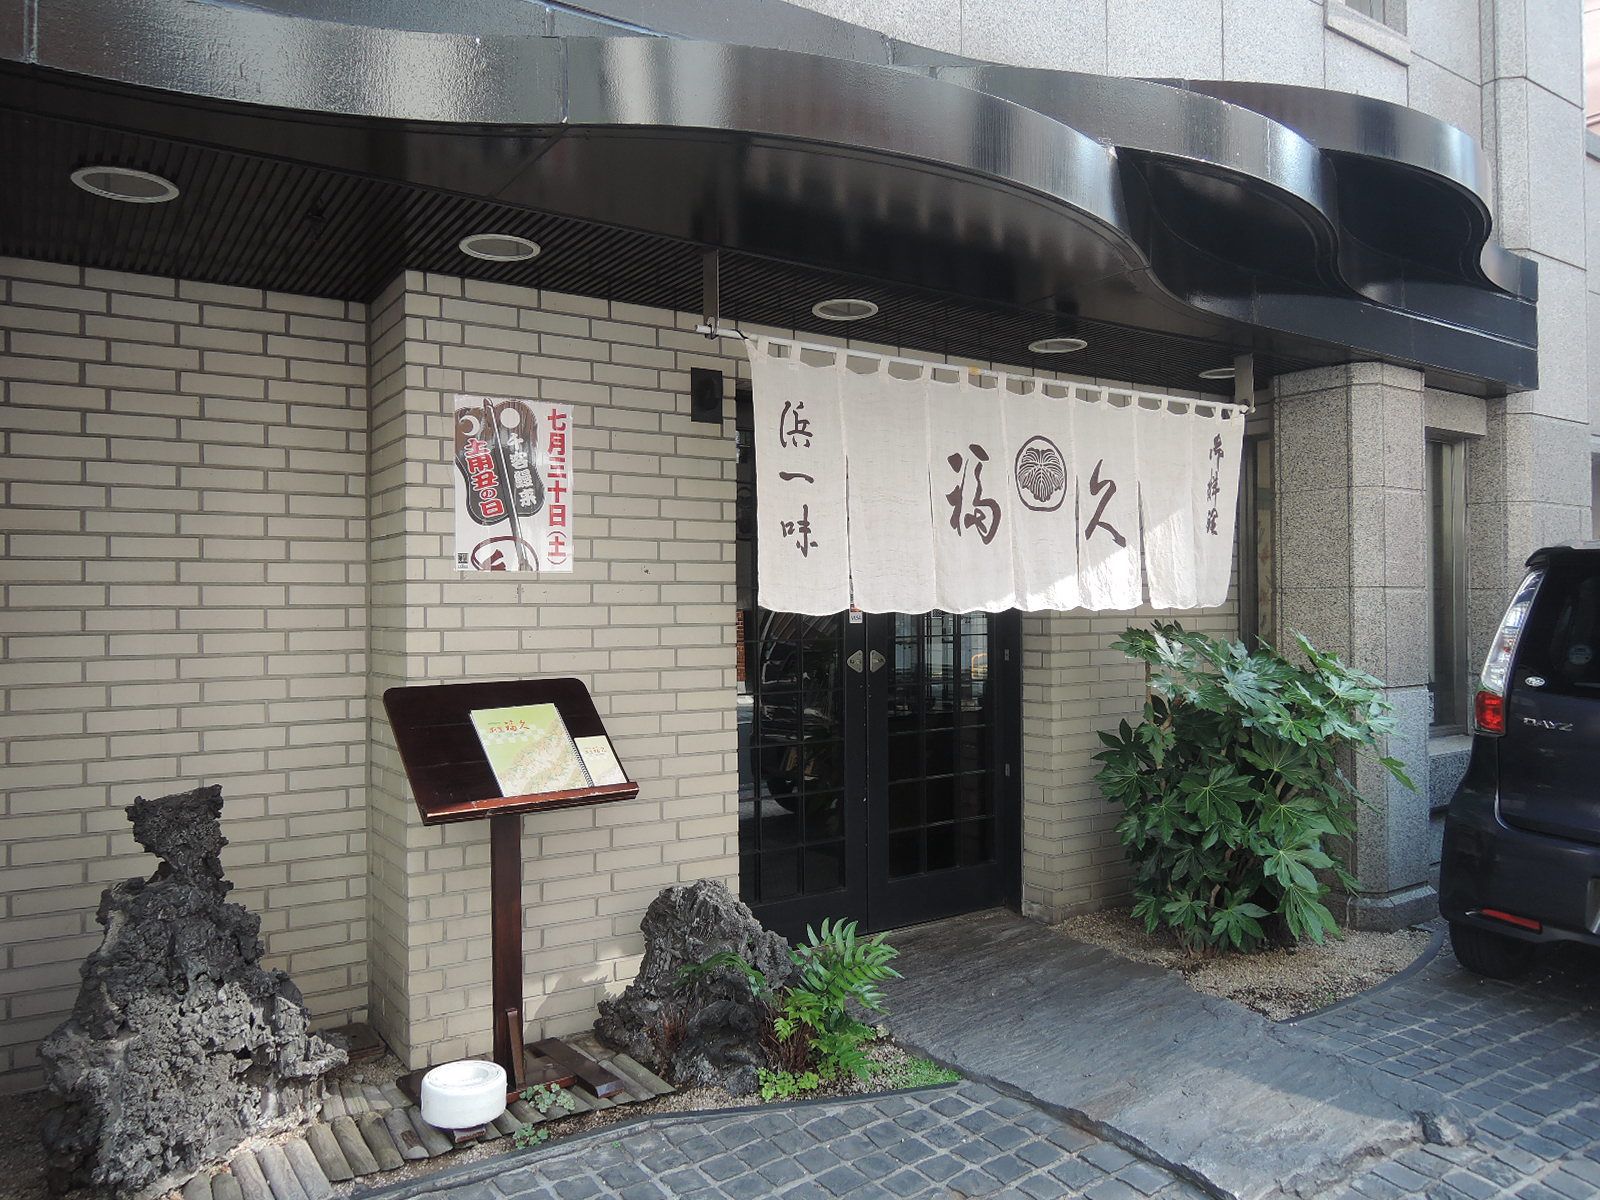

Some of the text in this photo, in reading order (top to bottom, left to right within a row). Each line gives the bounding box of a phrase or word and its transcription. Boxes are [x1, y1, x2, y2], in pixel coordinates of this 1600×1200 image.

[463, 438, 504, 518] 土用丑の日
[778, 400, 819, 558] 浜一味
[1523, 717, 1574, 731] DAYZ
